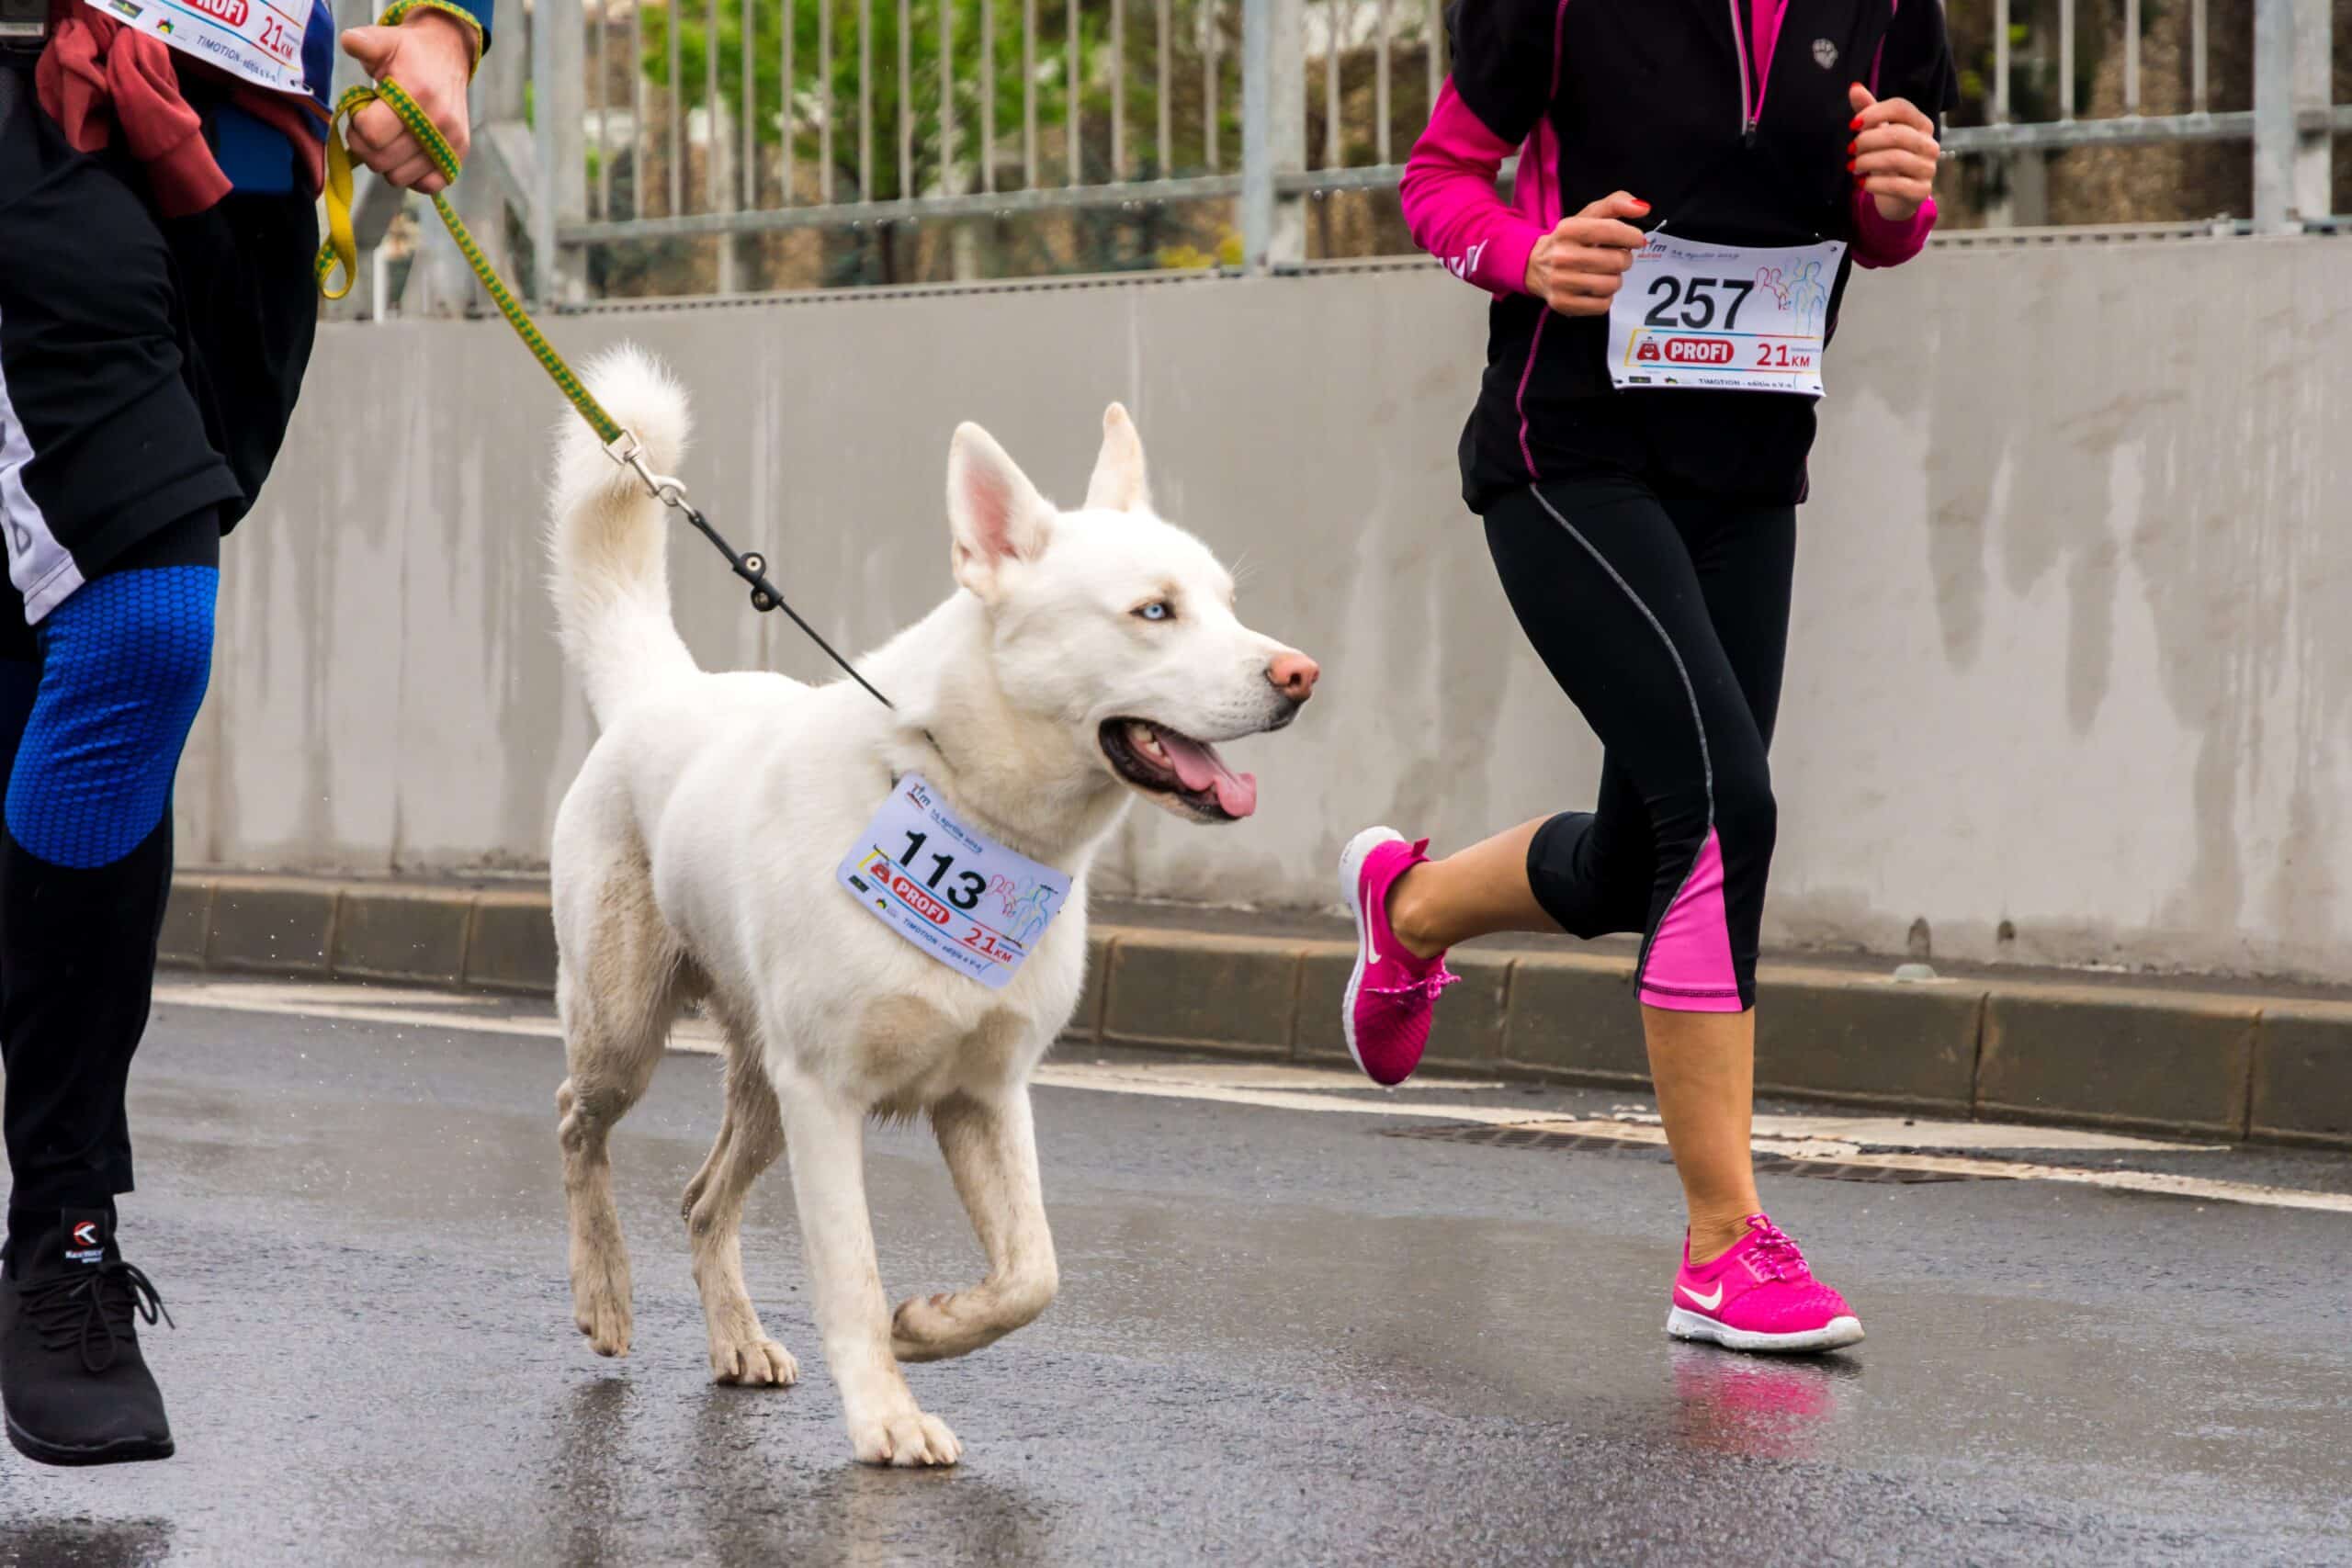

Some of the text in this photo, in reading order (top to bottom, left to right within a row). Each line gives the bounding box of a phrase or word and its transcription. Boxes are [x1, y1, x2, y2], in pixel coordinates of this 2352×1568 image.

[197, 35, 241, 62] TIMOTION
[1644, 275, 1755, 330] 257
[1669, 342, 1729, 362] PROFI
[1698, 378, 1741, 386] TIMOTION
[899, 829, 987, 910] 113
[896, 881, 945, 923] PROFI
[903, 918, 937, 945] TIMOTION
